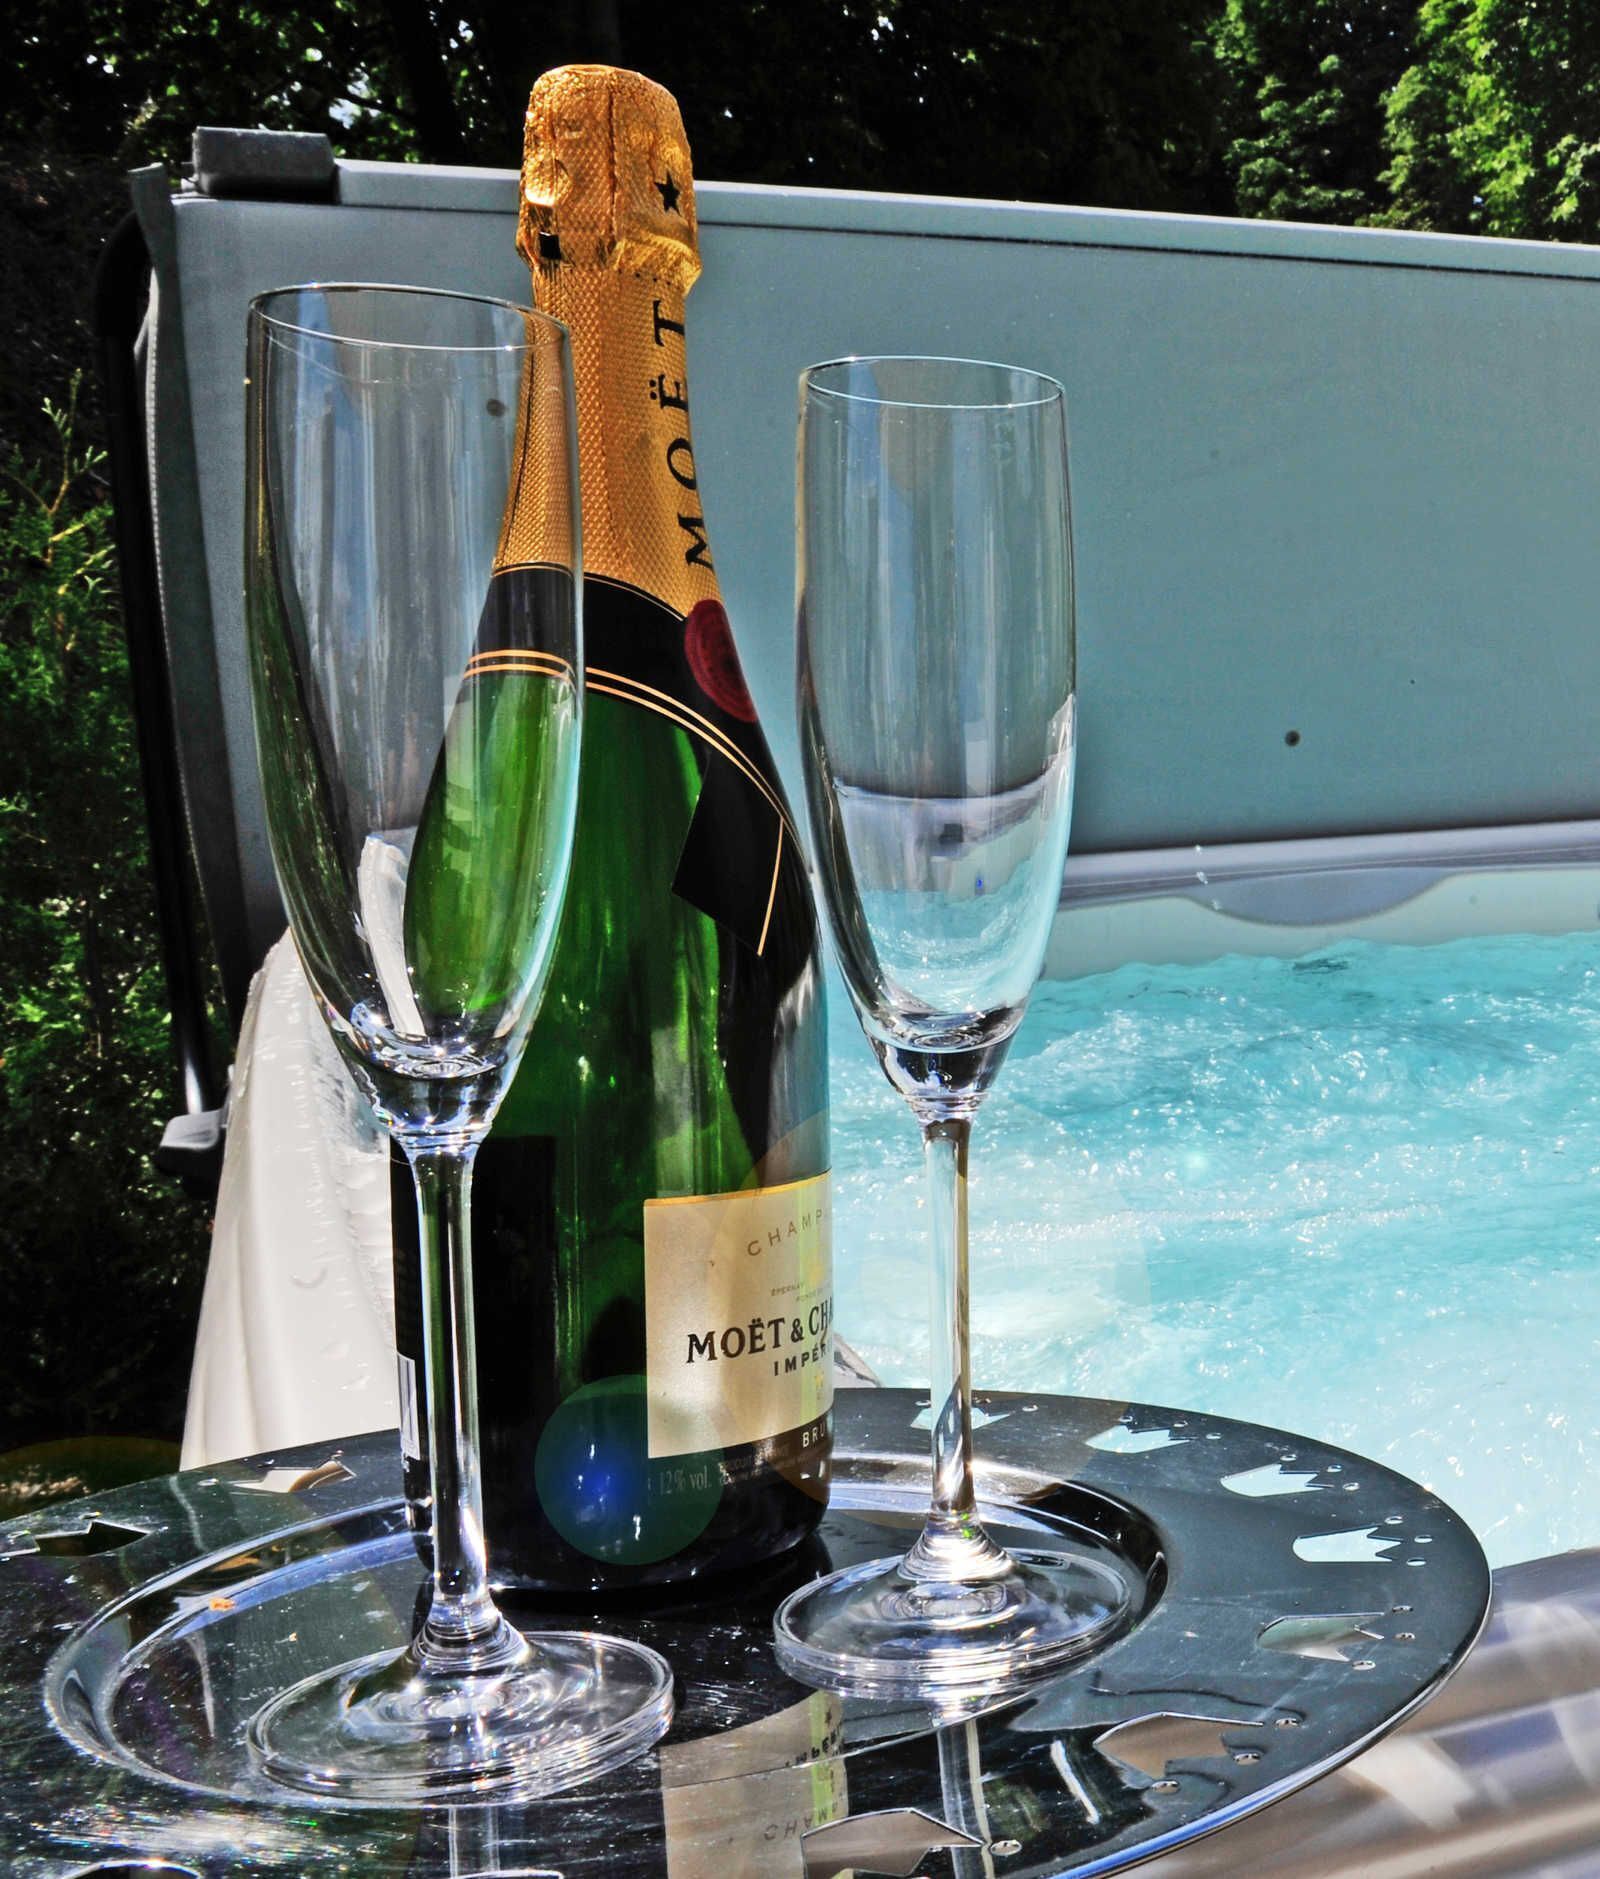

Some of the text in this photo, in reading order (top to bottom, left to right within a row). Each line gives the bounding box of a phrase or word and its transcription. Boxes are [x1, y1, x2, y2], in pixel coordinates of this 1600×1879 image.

[649, 299, 714, 573] MOËT
[747, 1208, 824, 1256] CHAMP
[686, 1317, 785, 1363] MOËT
[791, 1318, 804, 1343] &
[774, 1343, 827, 1376] IMPÉR
[803, 1422, 826, 1448] BRU
